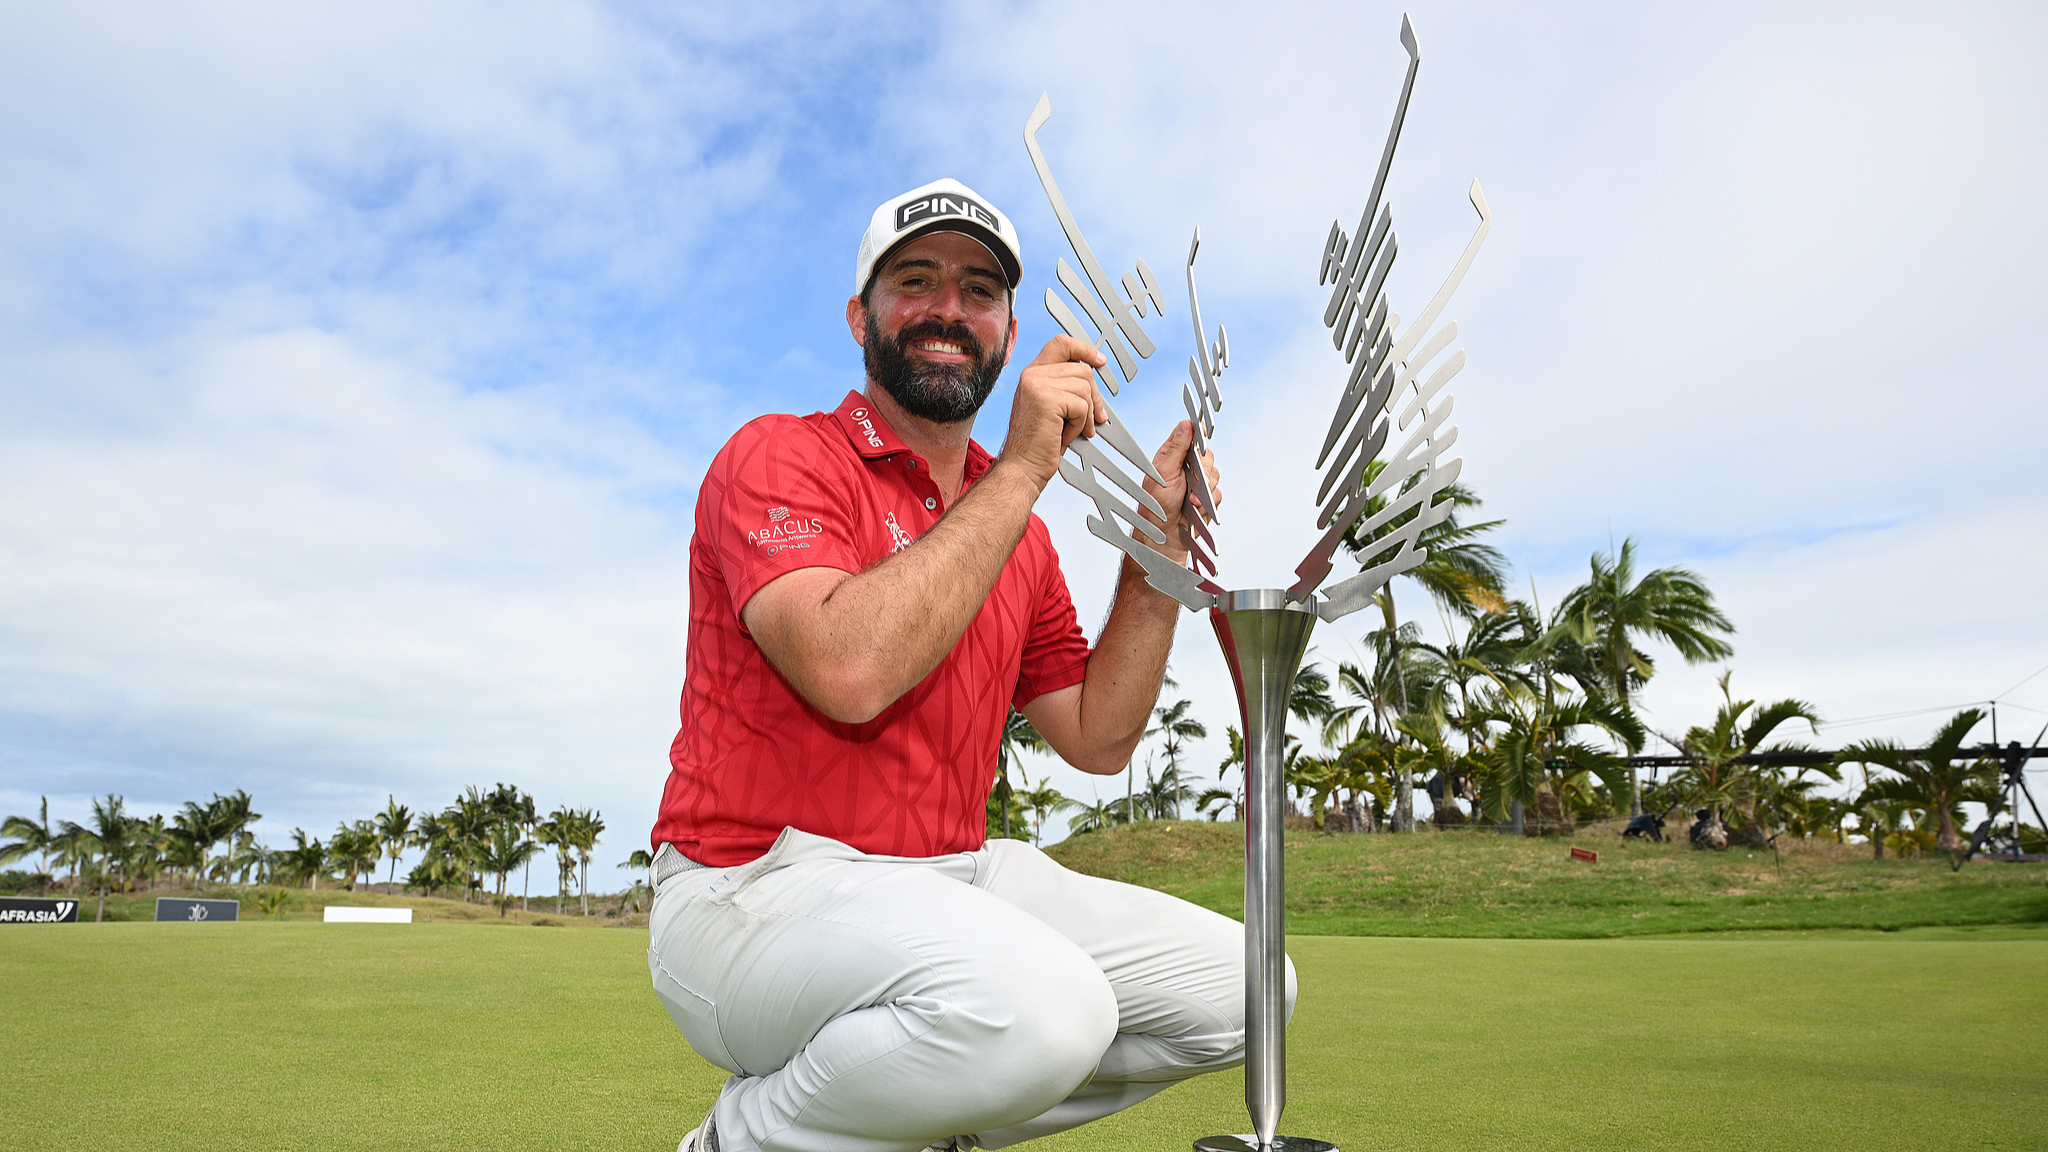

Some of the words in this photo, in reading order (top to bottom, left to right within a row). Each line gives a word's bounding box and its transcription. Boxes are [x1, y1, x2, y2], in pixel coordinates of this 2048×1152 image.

[903, 198, 994, 229] PING
[858, 419, 884, 448] PING
[748, 518, 823, 545] ABACUS
[779, 542, 810, 551] PING
[0, 910, 57, 922] AFRASIA
